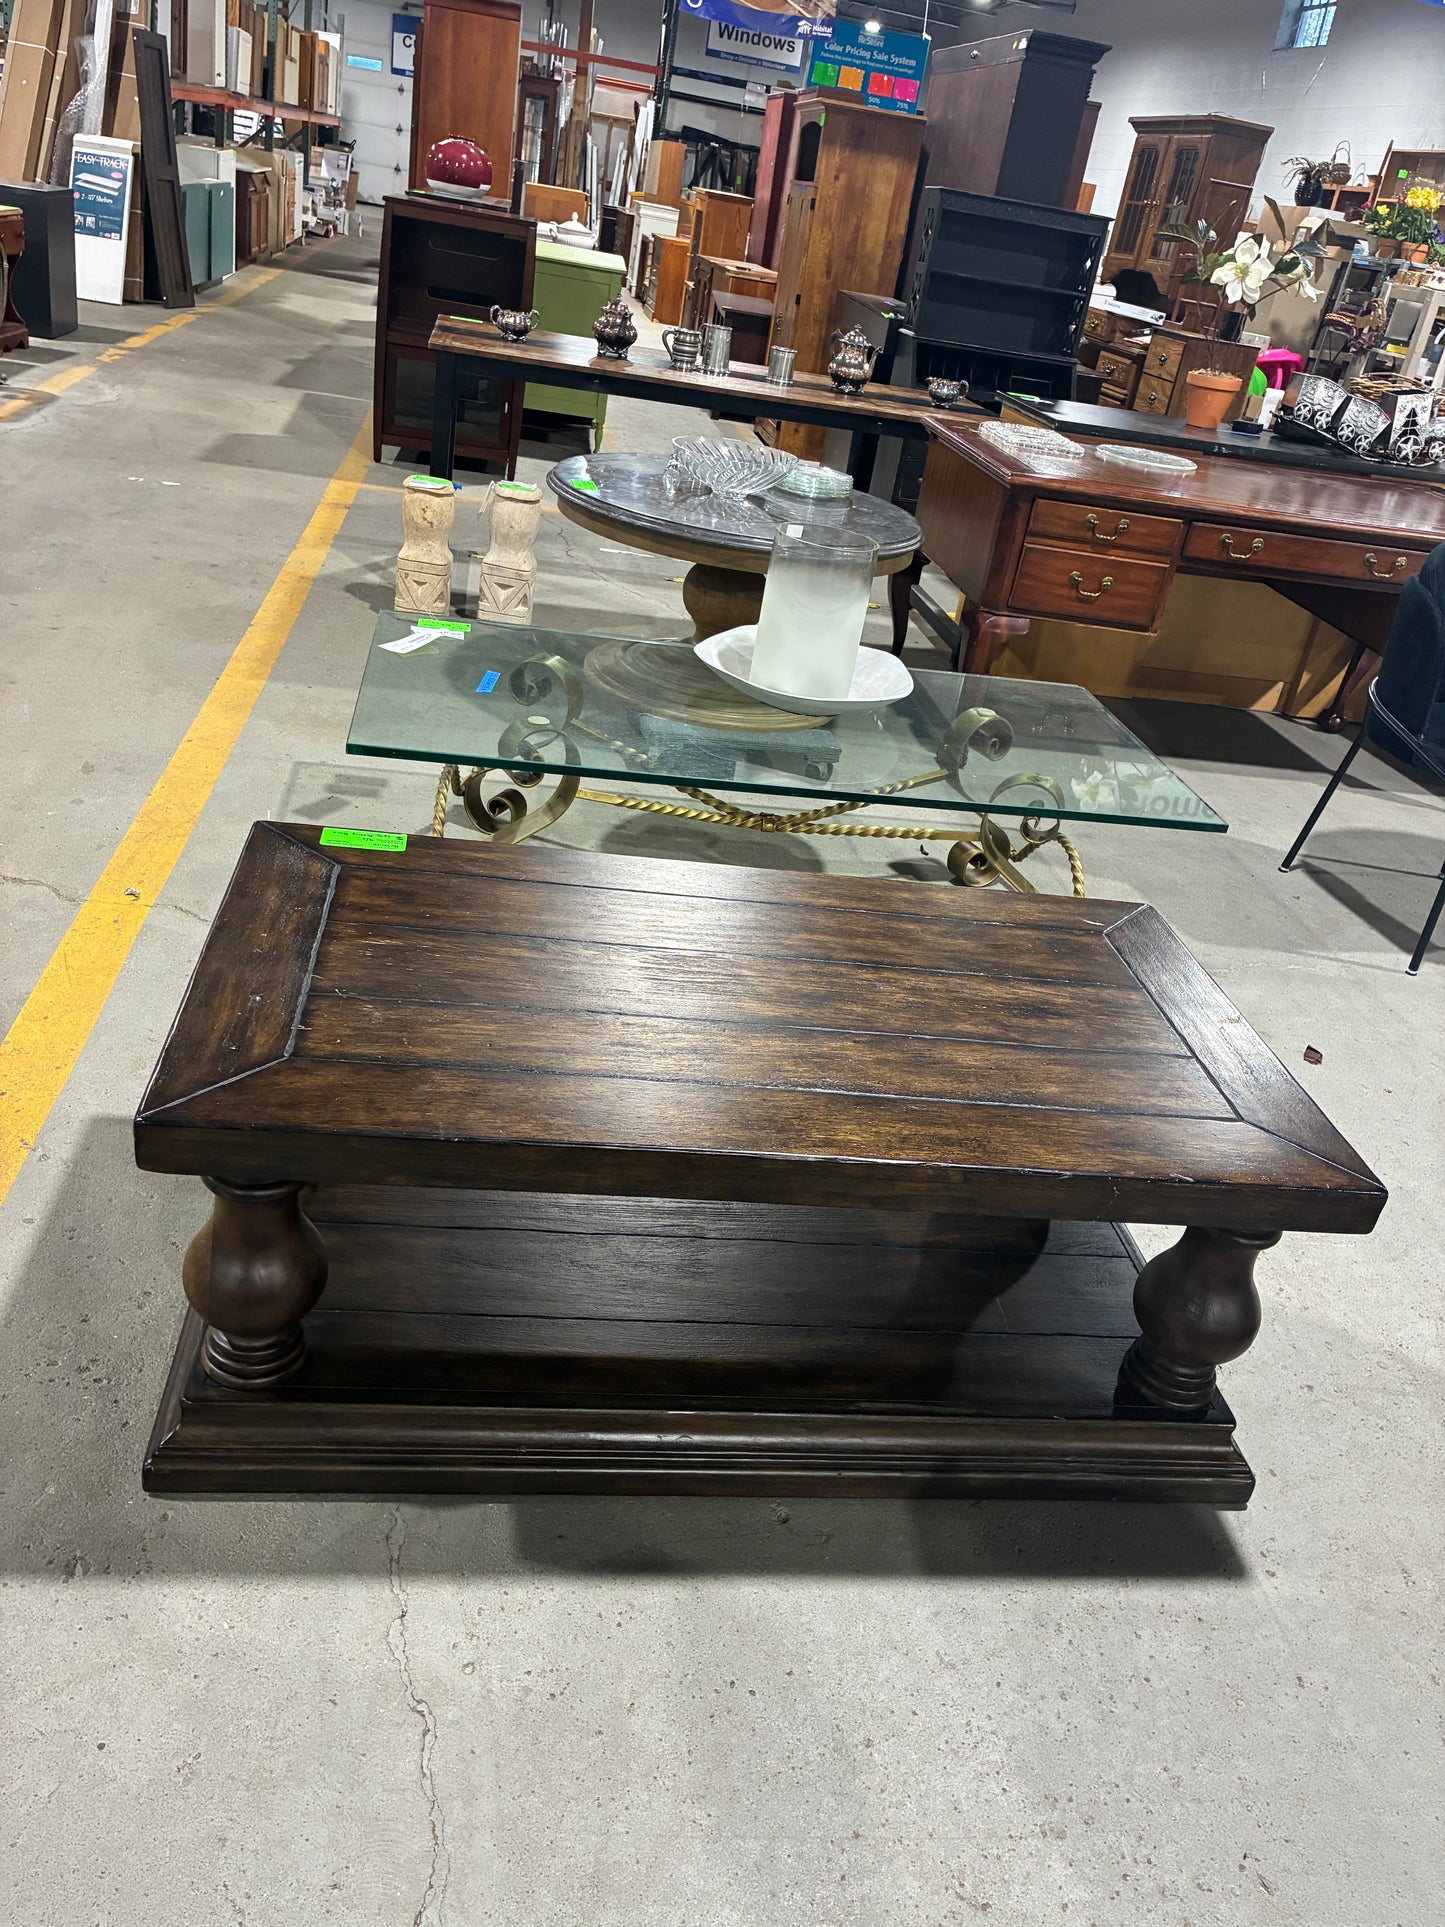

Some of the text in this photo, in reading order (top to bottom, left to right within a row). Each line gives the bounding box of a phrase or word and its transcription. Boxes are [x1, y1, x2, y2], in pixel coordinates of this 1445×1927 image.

[718, 22, 796, 53] Windows
[812, 25, 832, 34] Habitat
[824, 41, 917, 67] Color Pricing Sale System
[77, 153, 125, 169] EASY TRACK
